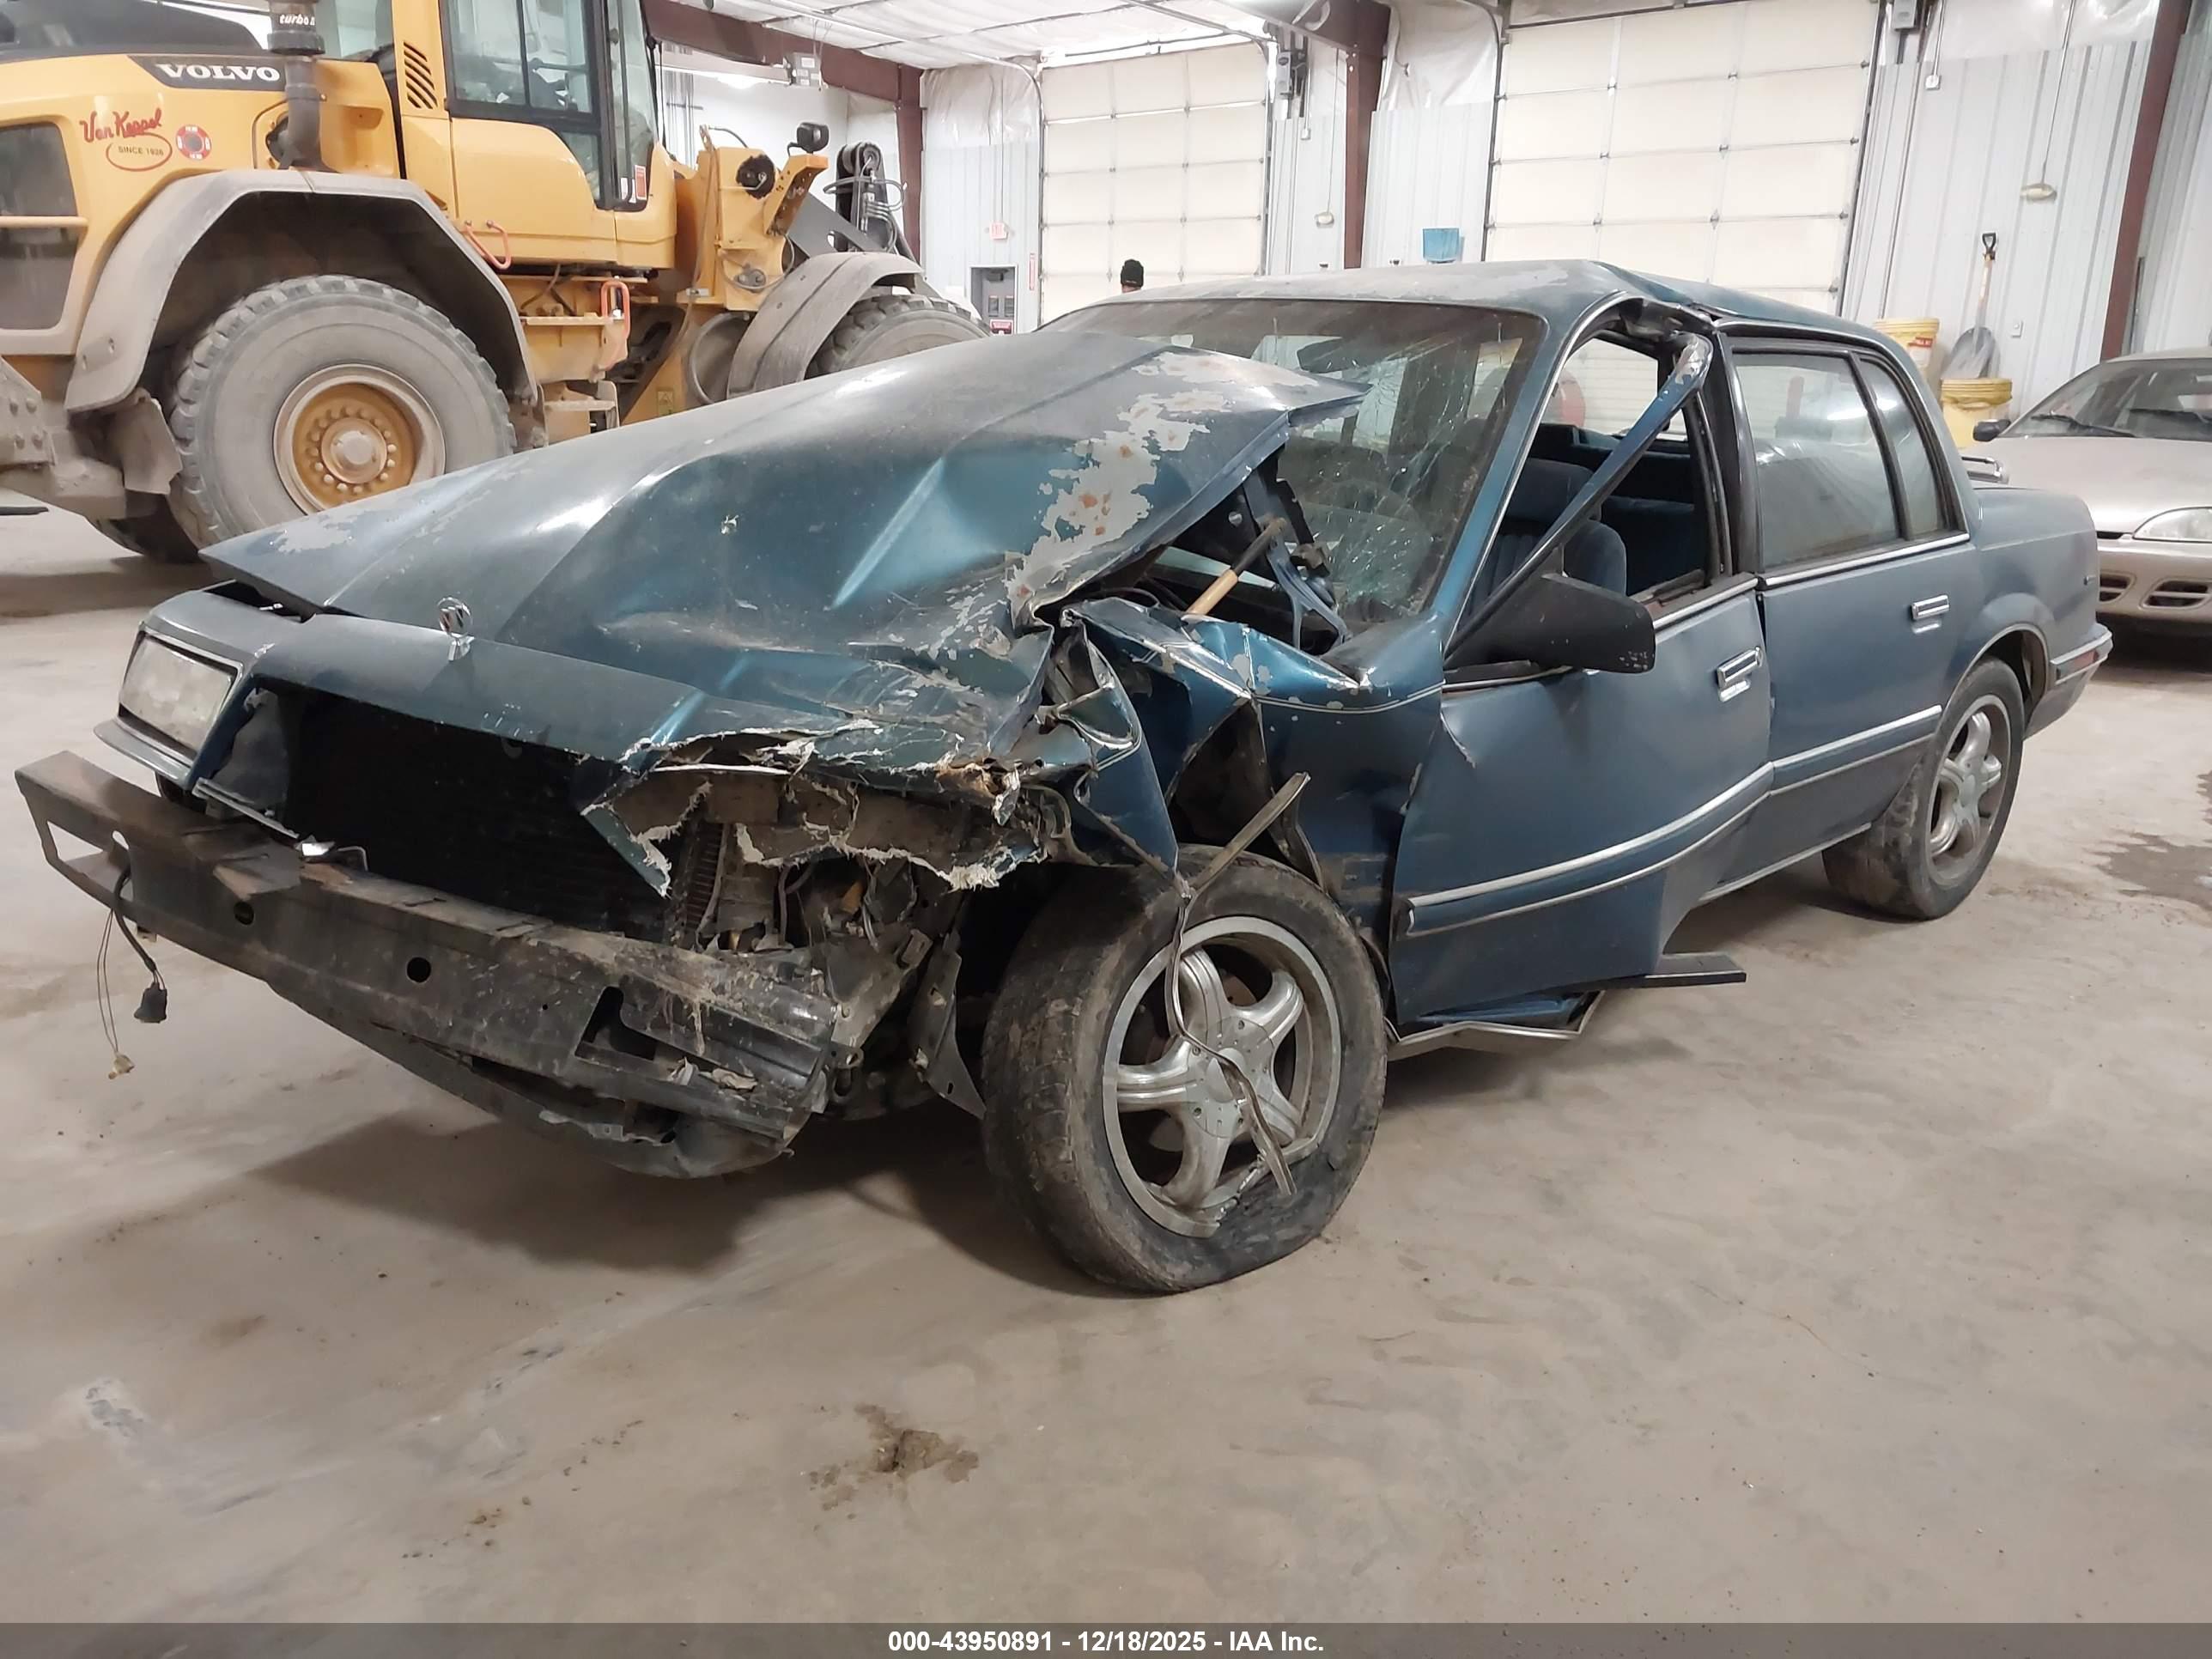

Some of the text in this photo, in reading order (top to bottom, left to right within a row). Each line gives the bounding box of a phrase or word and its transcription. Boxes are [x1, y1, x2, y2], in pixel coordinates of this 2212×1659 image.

[279, 14, 309, 26] turbo
[156, 64, 280, 81] VOLVO
[79, 111, 114, 143] Van
[118, 145, 143, 155] SINCE
